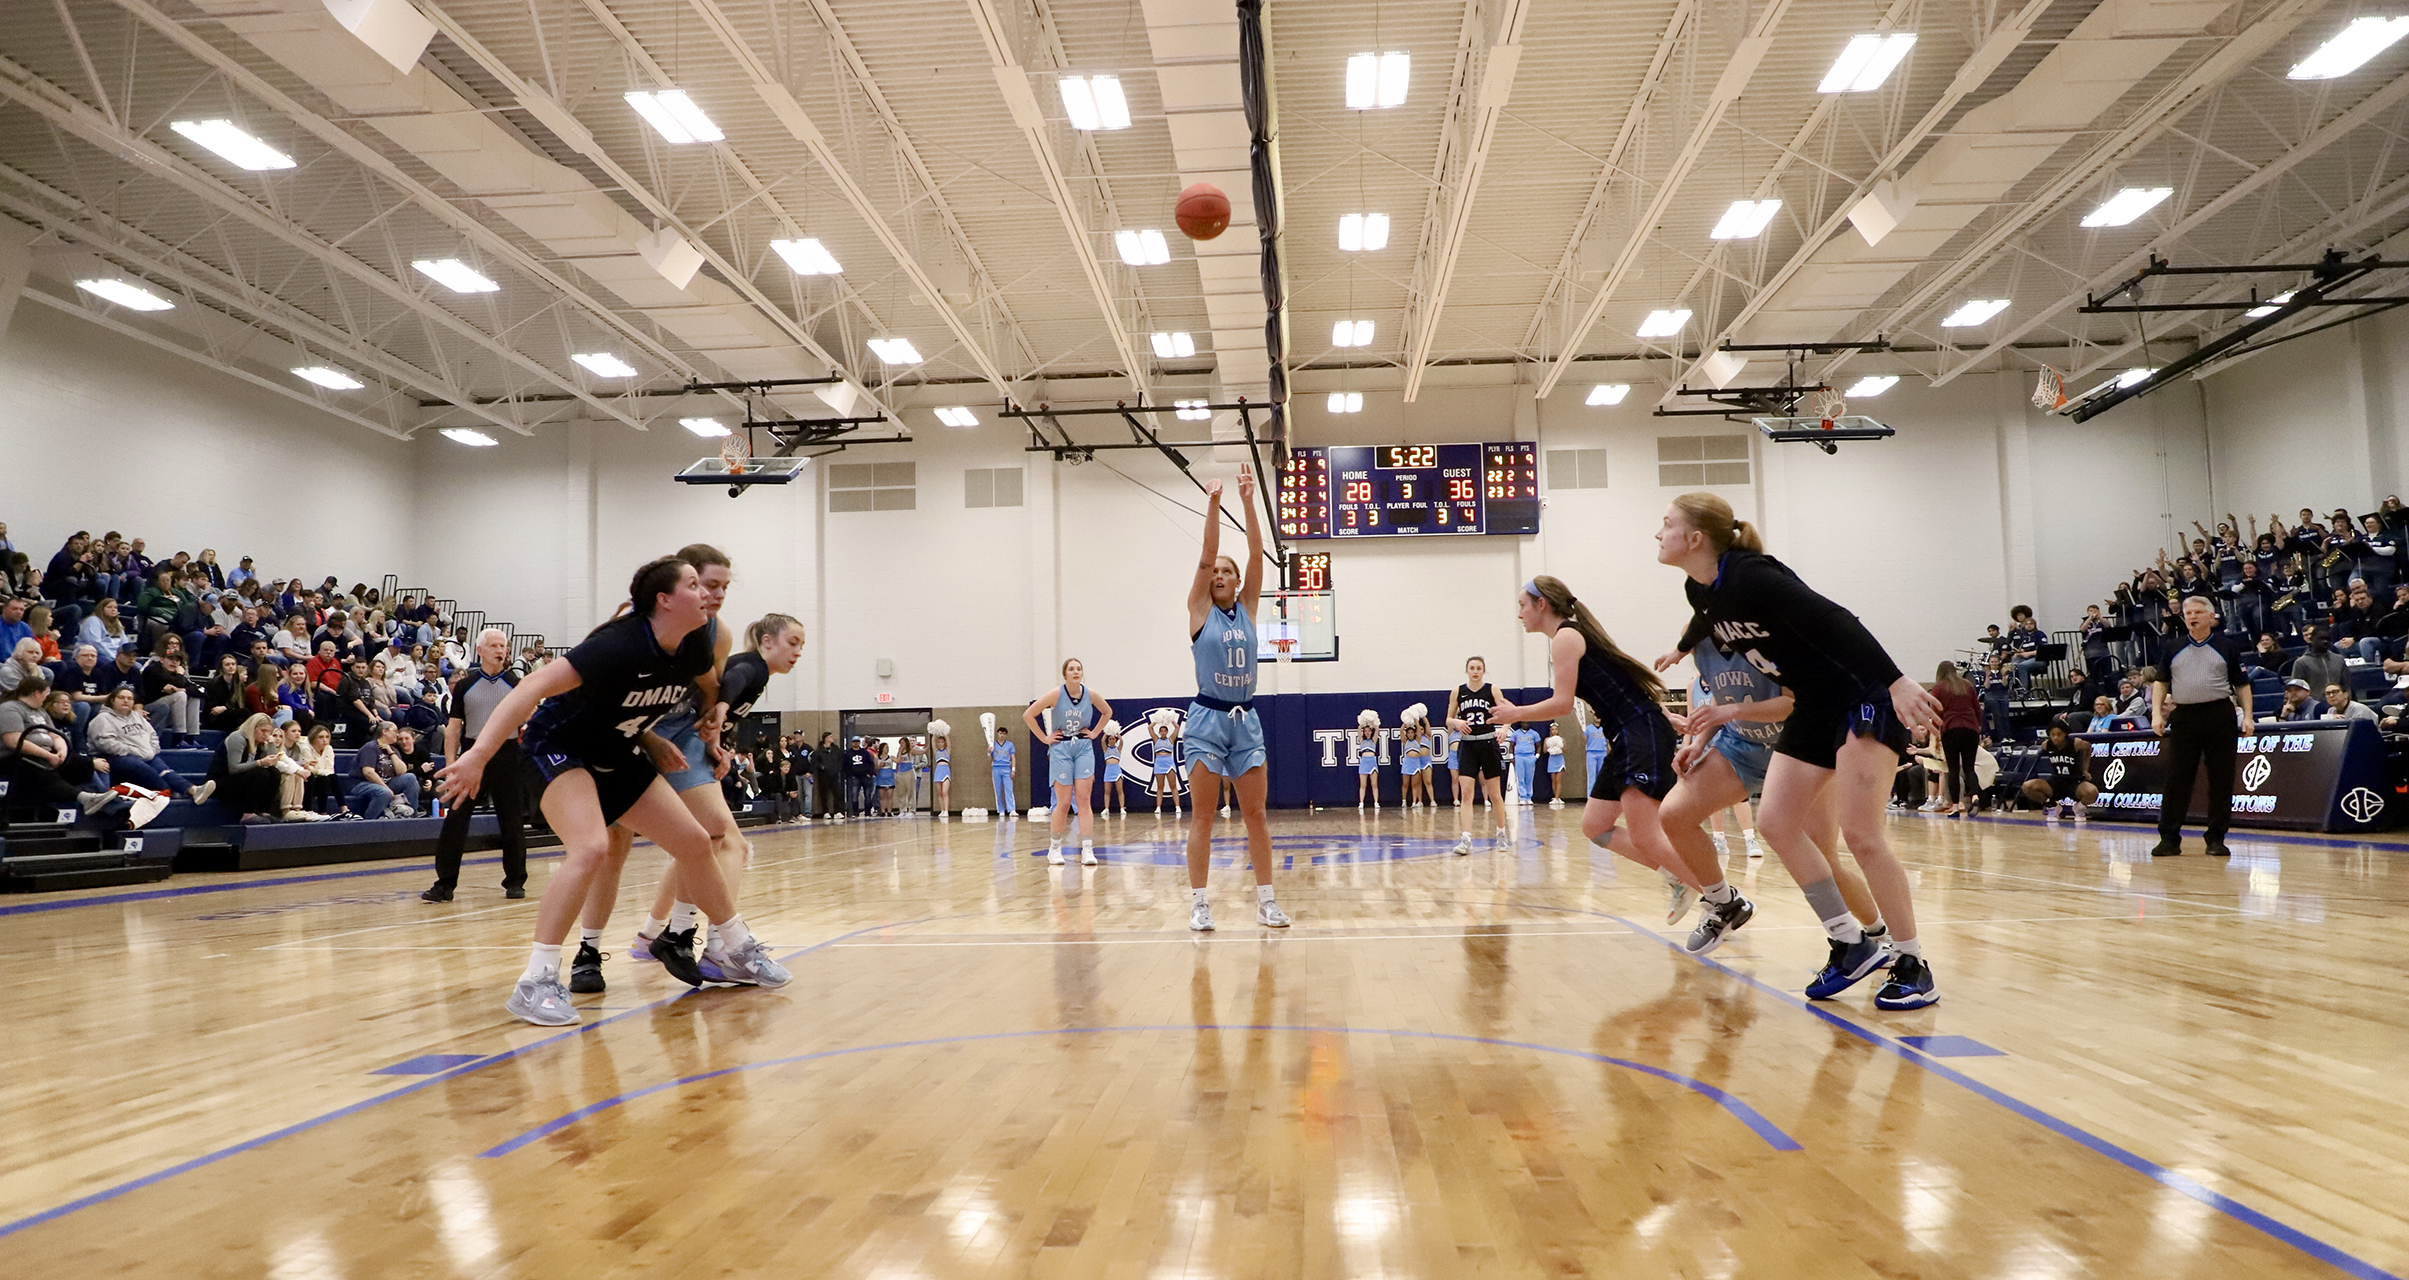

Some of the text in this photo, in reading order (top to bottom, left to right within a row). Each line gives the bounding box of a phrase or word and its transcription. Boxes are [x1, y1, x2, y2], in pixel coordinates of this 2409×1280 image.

[1391, 447, 1434, 467] 5:22
[1494, 454, 1534, 465] 4 1 9
[1284, 459, 1326, 472] 0 2 9
[1443, 468, 1471, 478] GUEST
[1283, 475, 1326, 487] 12 2 5
[1342, 471, 1368, 480] HOME
[1487, 470, 1534, 482] 22 2 4
[1280, 491, 1326, 503] 22 2 4
[1346, 482, 1372, 501] 28
[1402, 483, 1413, 499] 3
[1450, 479, 1475, 500] 36
[1488, 486, 1535, 498] 23 2 4
[1281, 506, 1327, 519] 34 2 2
[1347, 511, 1357, 526] 3
[1368, 510, 1379, 526] 3
[1437, 508, 1449, 524] 3
[1463, 508, 1475, 522] 4
[1281, 523, 1297, 534] 40
[1300, 523, 1308, 534] 0
[1299, 556, 1328, 568] 5:22
[1298, 568, 1323, 589] 30
[1713, 620, 1770, 643] MACC
[1227, 647, 1246, 669] 10
[1744, 648, 1781, 677] 4
[1714, 670, 1755, 690] IOWA
[621, 685, 689, 708] DMAC
[878, 693, 891, 703] EXIT
[1460, 699, 1490, 711] DMACC
[1065, 709, 1082, 719] IOWA
[1466, 711, 1485, 725] 23
[1732, 718, 1785, 740] TRAL
[2091, 741, 2161, 757] OWA CENTRAL
[2236, 734, 2314, 753] ME OF THE
[2231, 795, 2277, 813] ITONS
